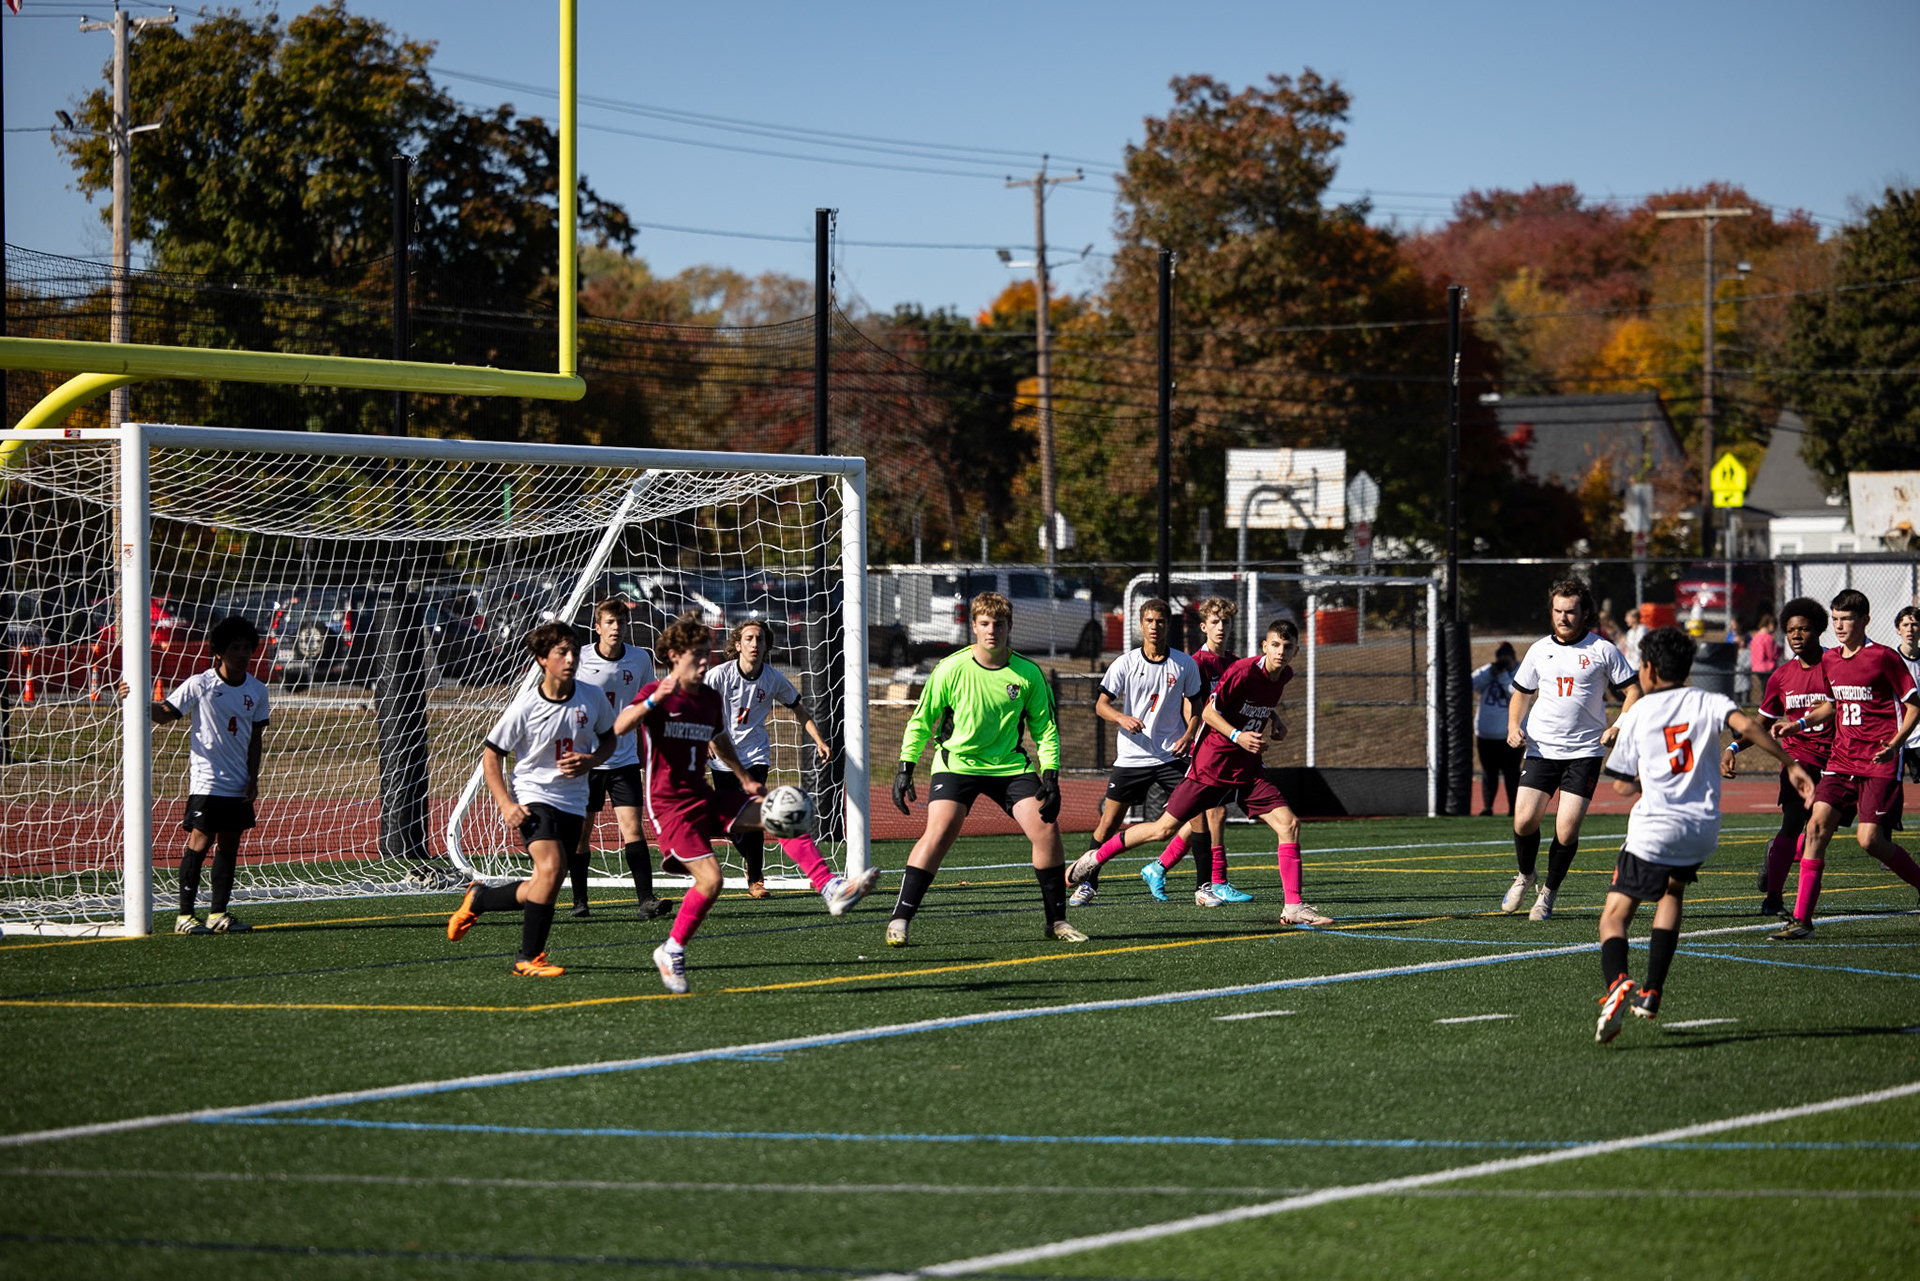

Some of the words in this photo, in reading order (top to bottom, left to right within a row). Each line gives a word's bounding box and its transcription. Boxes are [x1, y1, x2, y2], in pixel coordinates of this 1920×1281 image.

[1556, 676, 1574, 697] 17
[1150, 693, 1160, 712] 7
[737, 706, 750, 725] 11
[1841, 702, 1862, 726] 22
[227, 716, 238, 736] 4
[555, 737, 574, 760] 13
[688, 746, 697, 771] 1
[1663, 722, 1694, 775] 5
